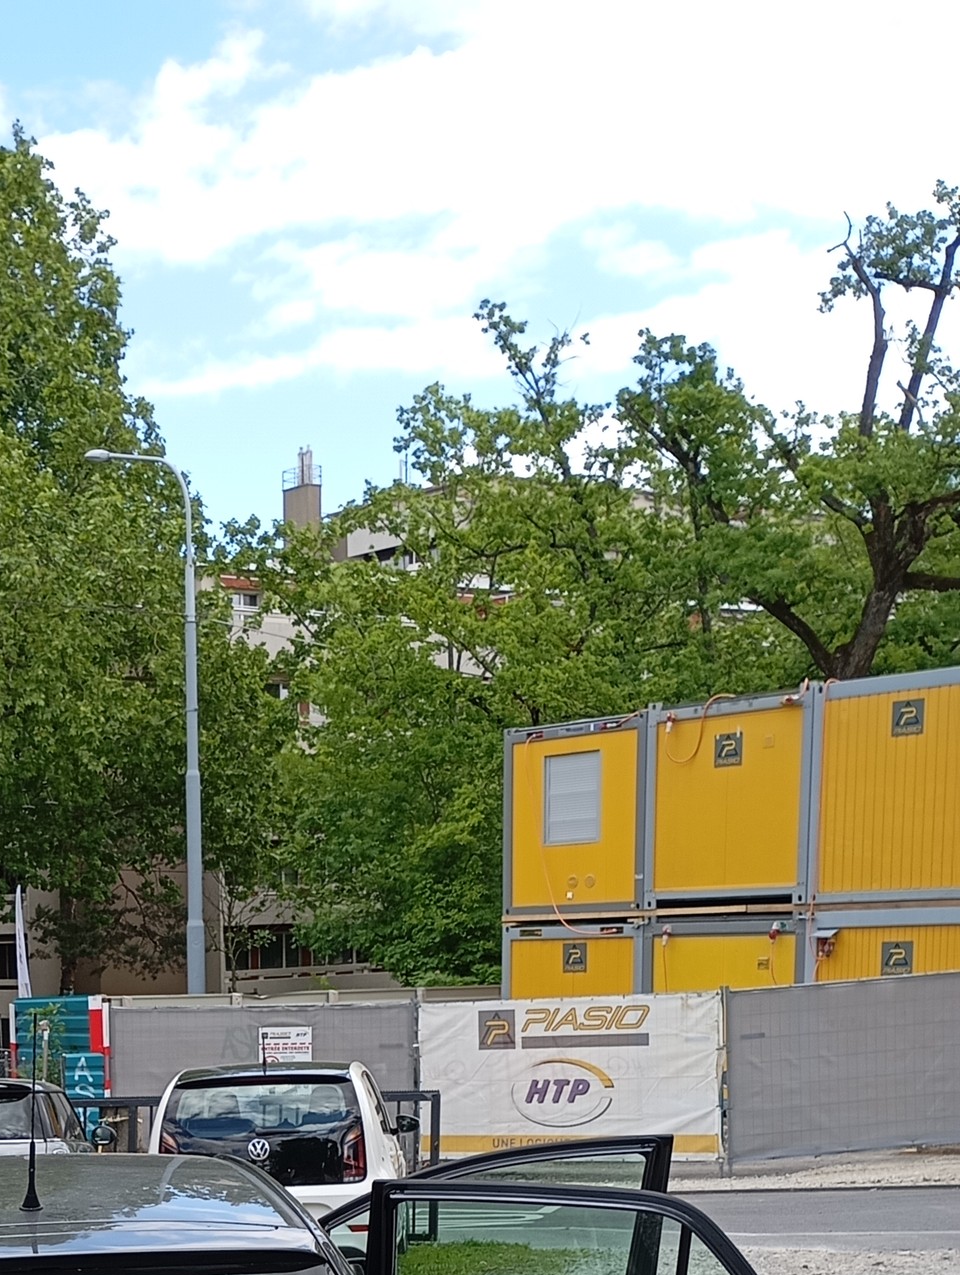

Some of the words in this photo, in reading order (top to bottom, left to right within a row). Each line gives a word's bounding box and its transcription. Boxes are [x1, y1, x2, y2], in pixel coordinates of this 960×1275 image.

[521, 1005, 650, 1032] PIASIO
[525, 1079, 590, 1103] HTP
[492, 1138, 516, 1148] UNE
